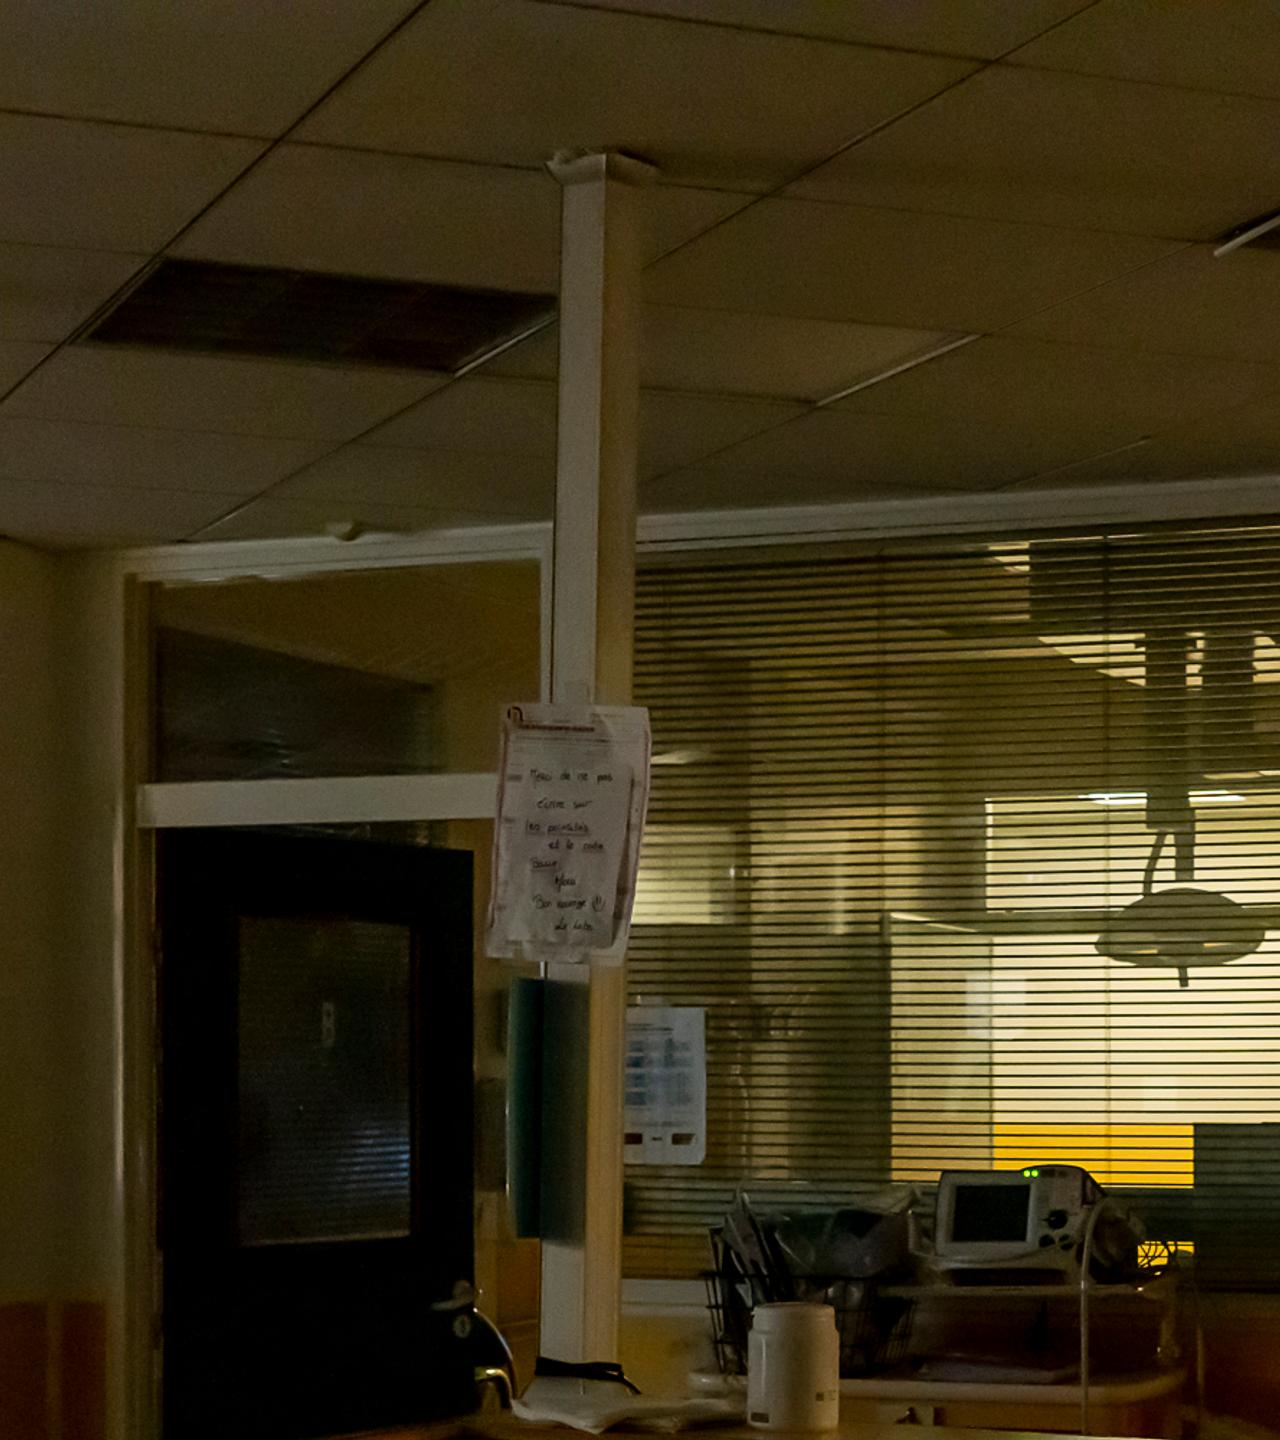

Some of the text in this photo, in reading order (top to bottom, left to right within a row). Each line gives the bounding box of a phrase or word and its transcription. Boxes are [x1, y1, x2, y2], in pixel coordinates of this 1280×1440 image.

[560, 770, 571, 781] de
[577, 772, 588, 781] ne
[596, 772, 613, 785] pas
[548, 838, 560, 850] et
[566, 838, 575, 850] le
